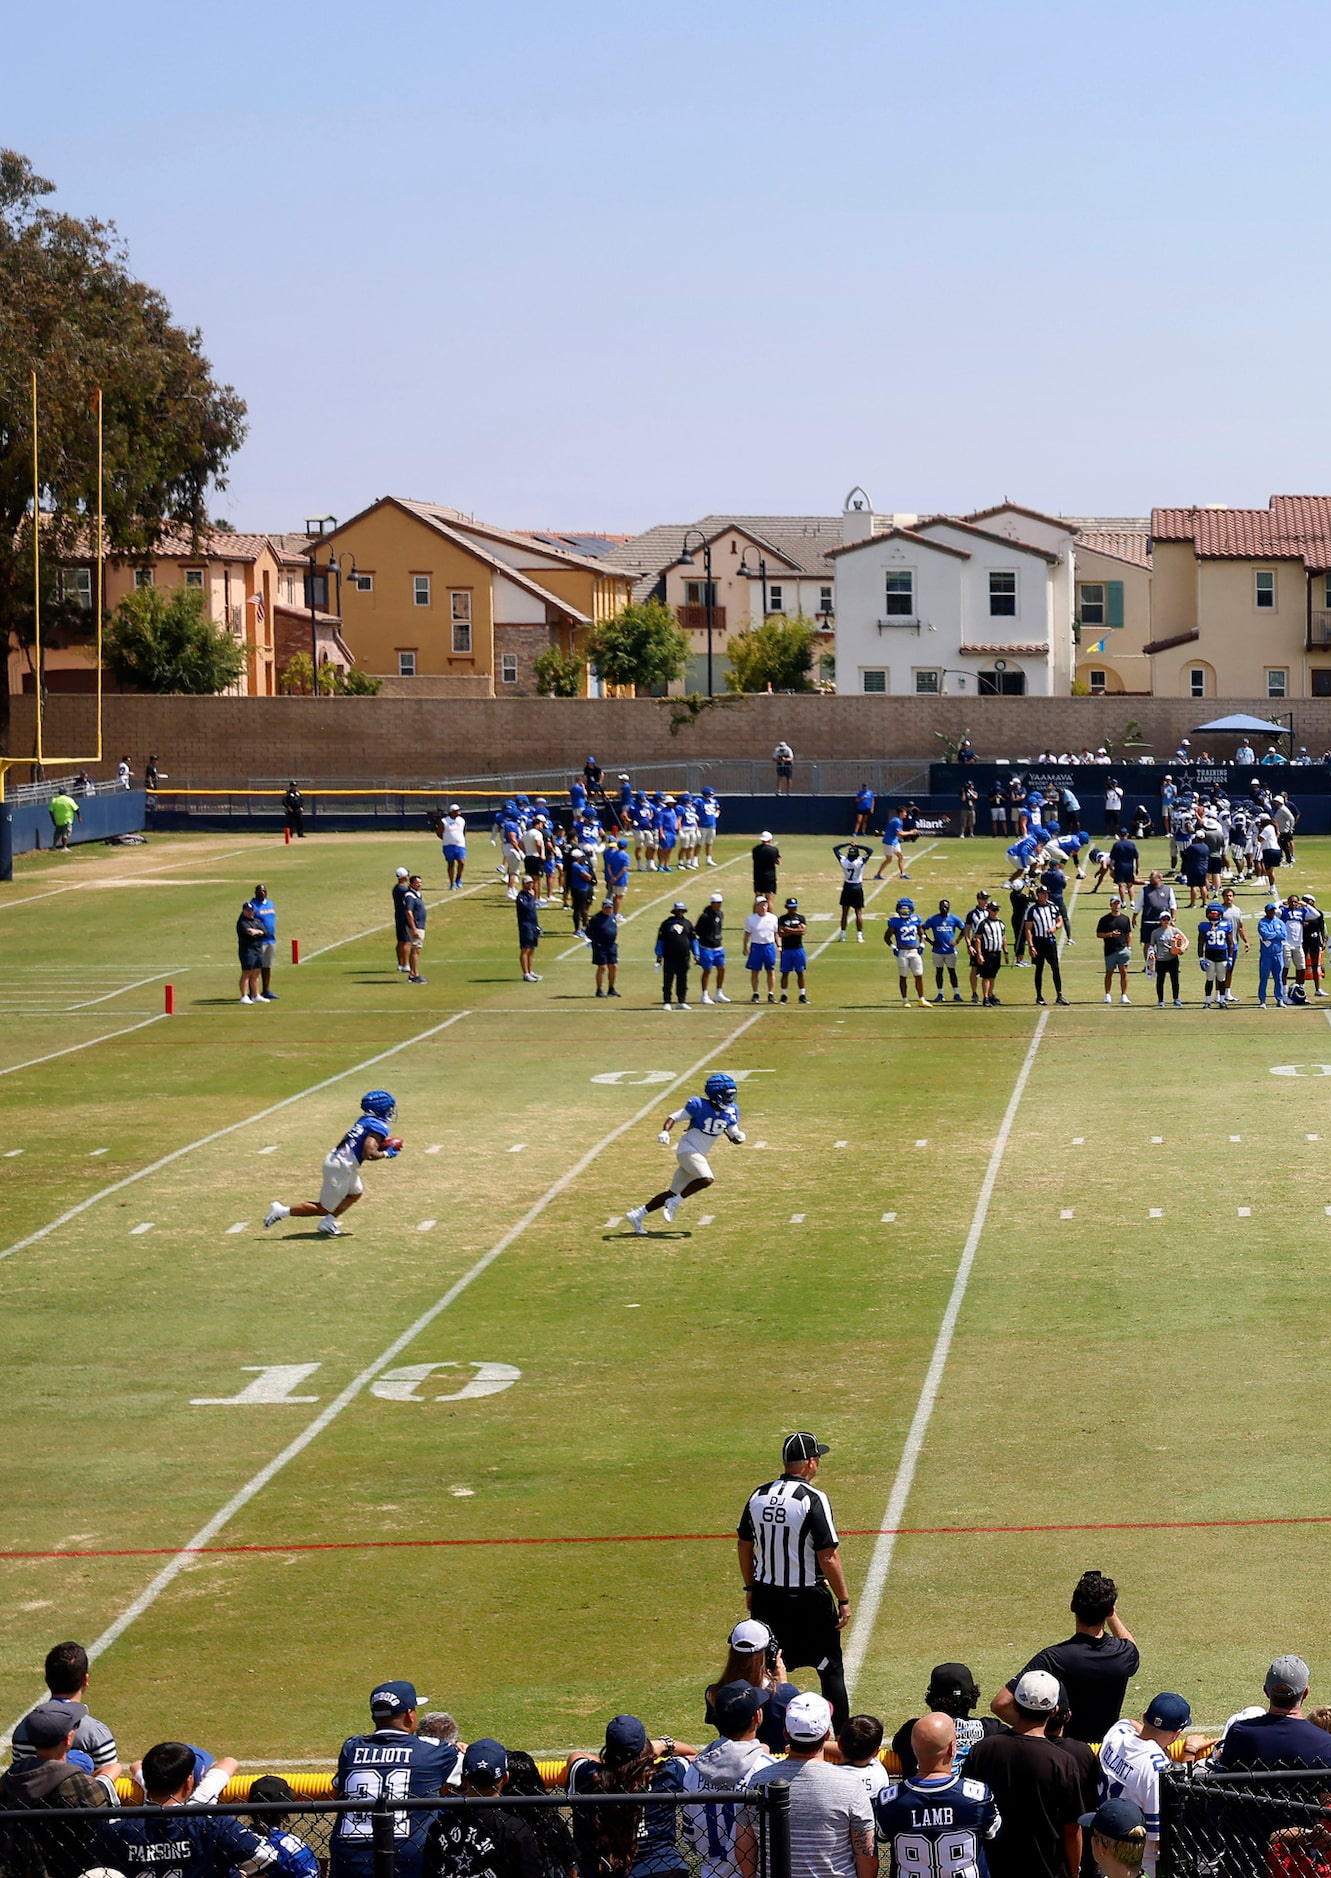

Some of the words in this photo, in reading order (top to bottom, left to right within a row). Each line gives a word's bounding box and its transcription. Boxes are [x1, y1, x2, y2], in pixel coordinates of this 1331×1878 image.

[847, 868, 855, 880] 7
[901, 925, 918, 941] 23
[1207, 930, 1226, 945] 30
[190, 1362, 521, 1403] 10
[762, 1507, 786, 1524] 68
[353, 1747, 413, 1764] ELLIOTT
[1101, 1746, 1136, 1781] ELLIOTT
[341, 1768, 412, 1838] 21
[911, 1809, 953, 1828] LAMB
[128, 1840, 192, 1862] PARSONS
[893, 1830, 978, 1878] 88
